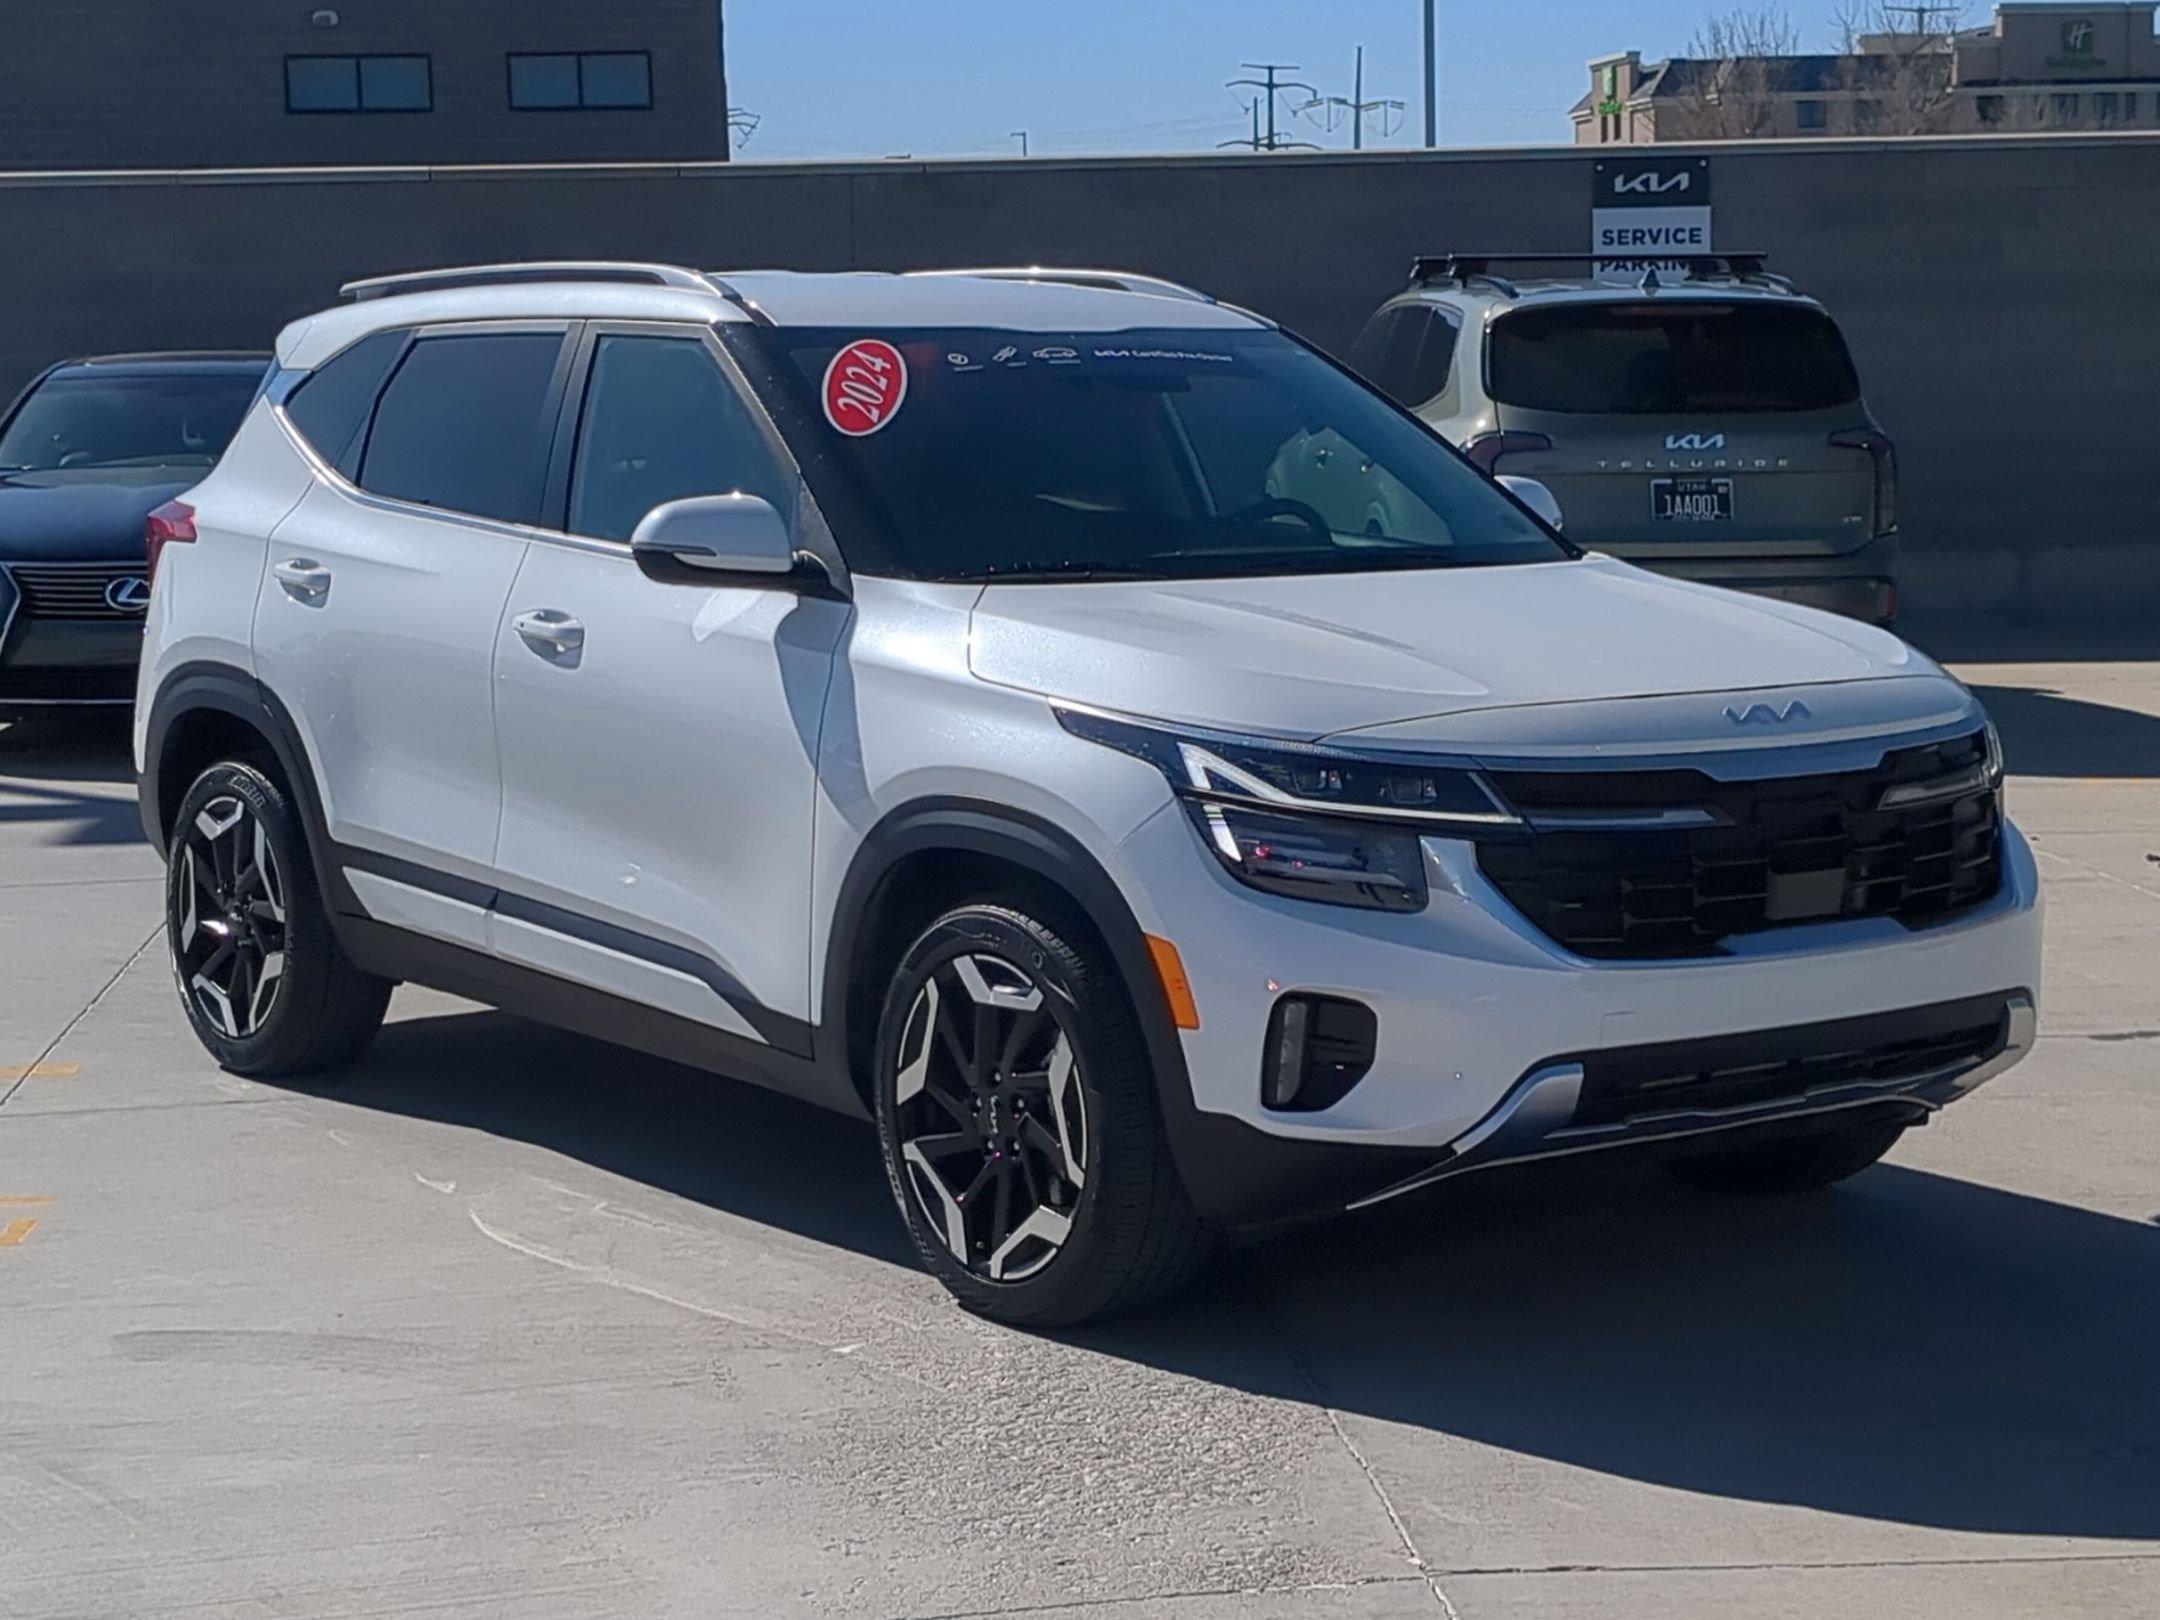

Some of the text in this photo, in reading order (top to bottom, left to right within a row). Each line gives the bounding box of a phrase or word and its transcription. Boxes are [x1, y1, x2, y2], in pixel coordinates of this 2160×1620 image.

[1614, 171, 1690, 193] KIA
[1601, 227, 1703, 246] SERVICE
[1599, 258, 1690, 273] PARKIN
[836, 348, 892, 424] 2024
[1664, 433, 1725, 450] KIA
[1597, 459, 1789, 469] TELLURIDE
[1664, 494, 1721, 516] 1AA001
